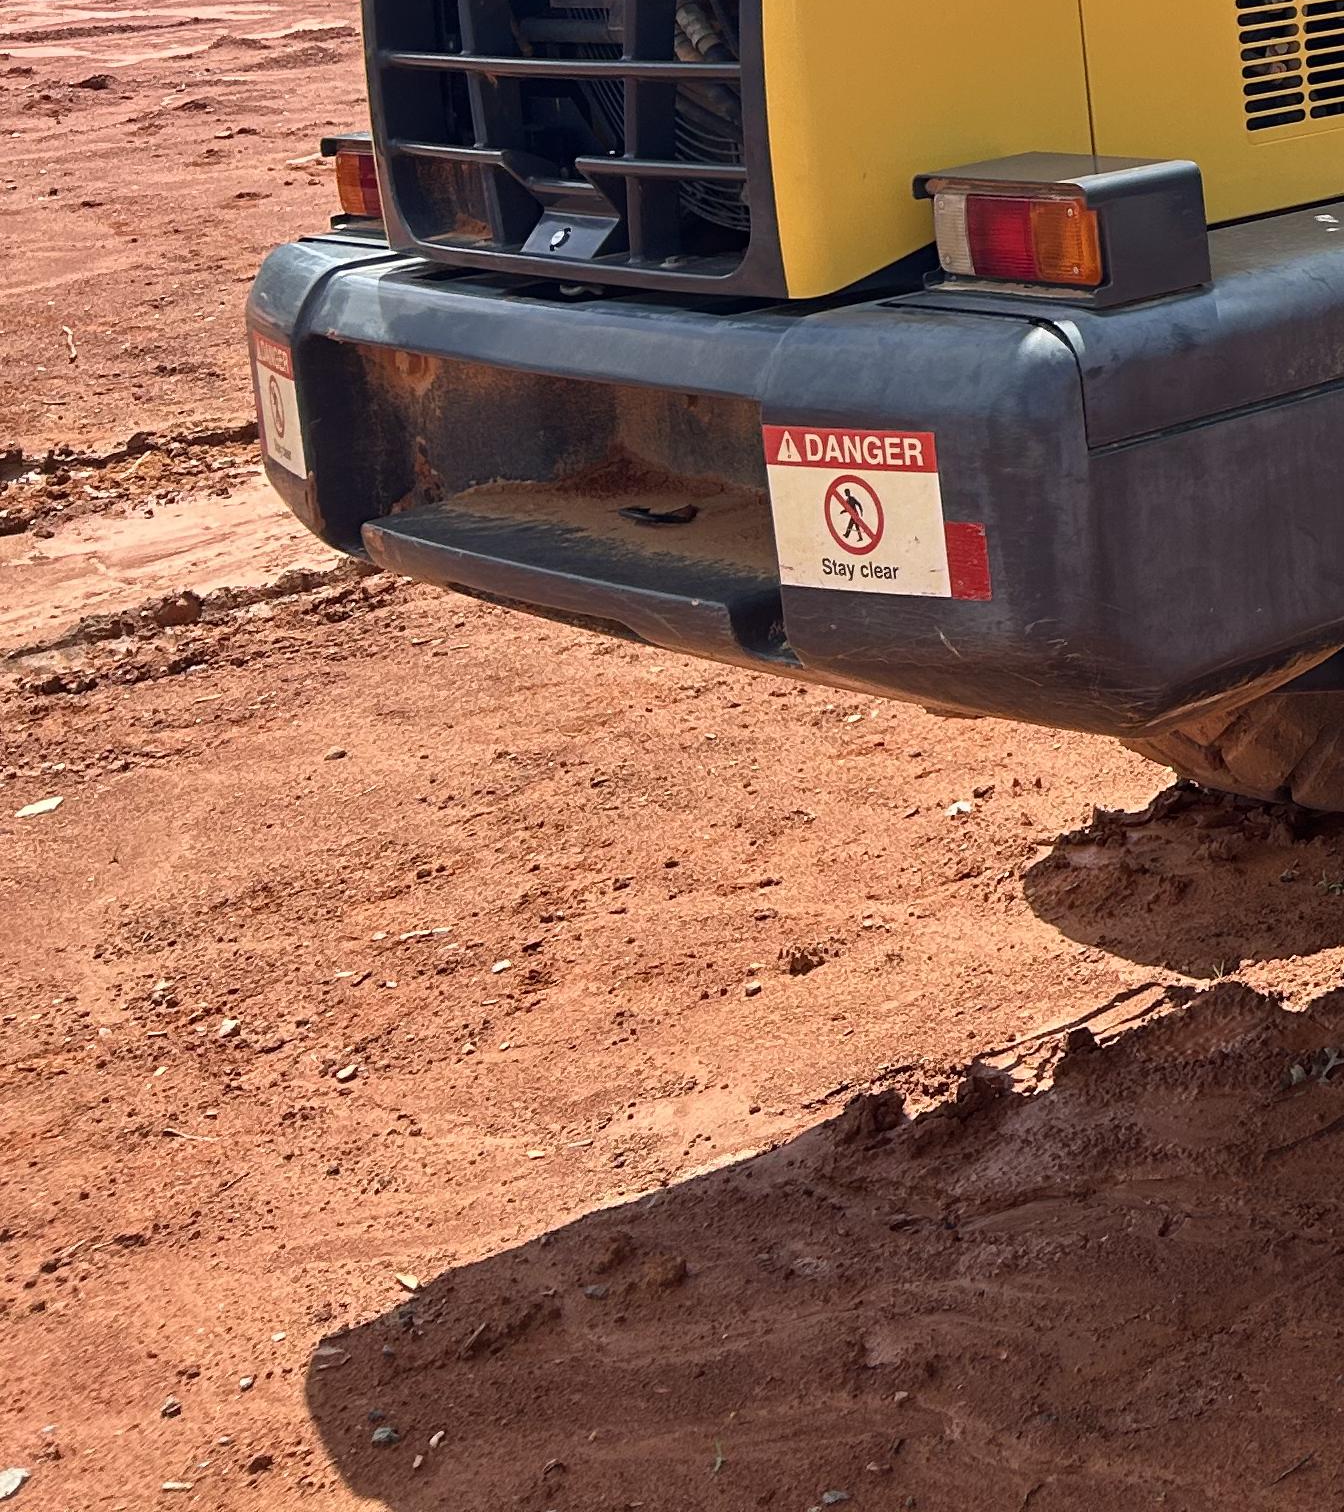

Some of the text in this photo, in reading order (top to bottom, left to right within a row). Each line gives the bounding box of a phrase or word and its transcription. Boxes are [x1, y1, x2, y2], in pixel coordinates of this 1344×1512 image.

[804, 433, 925, 466] DANGER
[822, 558, 900, 581] Stay clear
